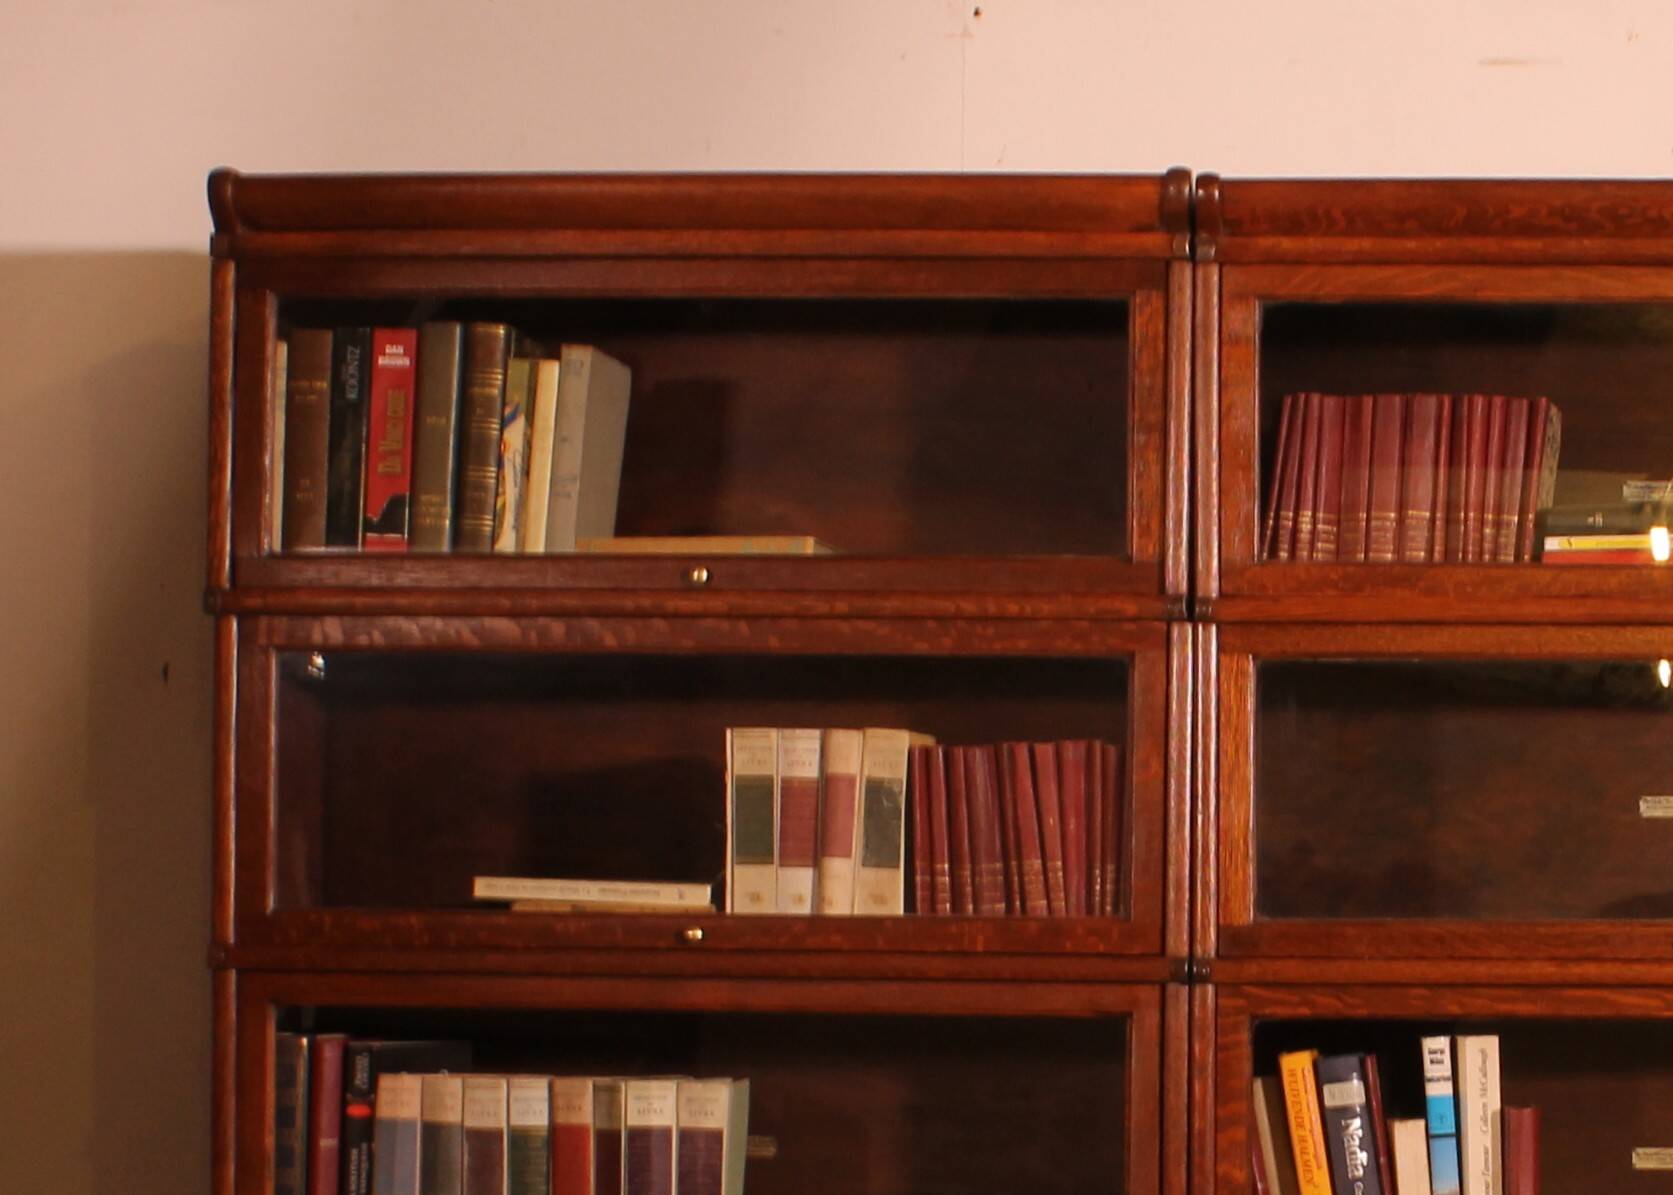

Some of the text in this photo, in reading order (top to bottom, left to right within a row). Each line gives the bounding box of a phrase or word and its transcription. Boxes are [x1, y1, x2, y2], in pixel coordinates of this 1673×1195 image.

[378, 355, 410, 367] BROWN
[385, 344, 404, 355] DAN
[345, 345, 360, 399] KOONTZ
[1480, 1102, 1490, 1135] Colleen
[1341, 1116, 1368, 1180] Nadia
